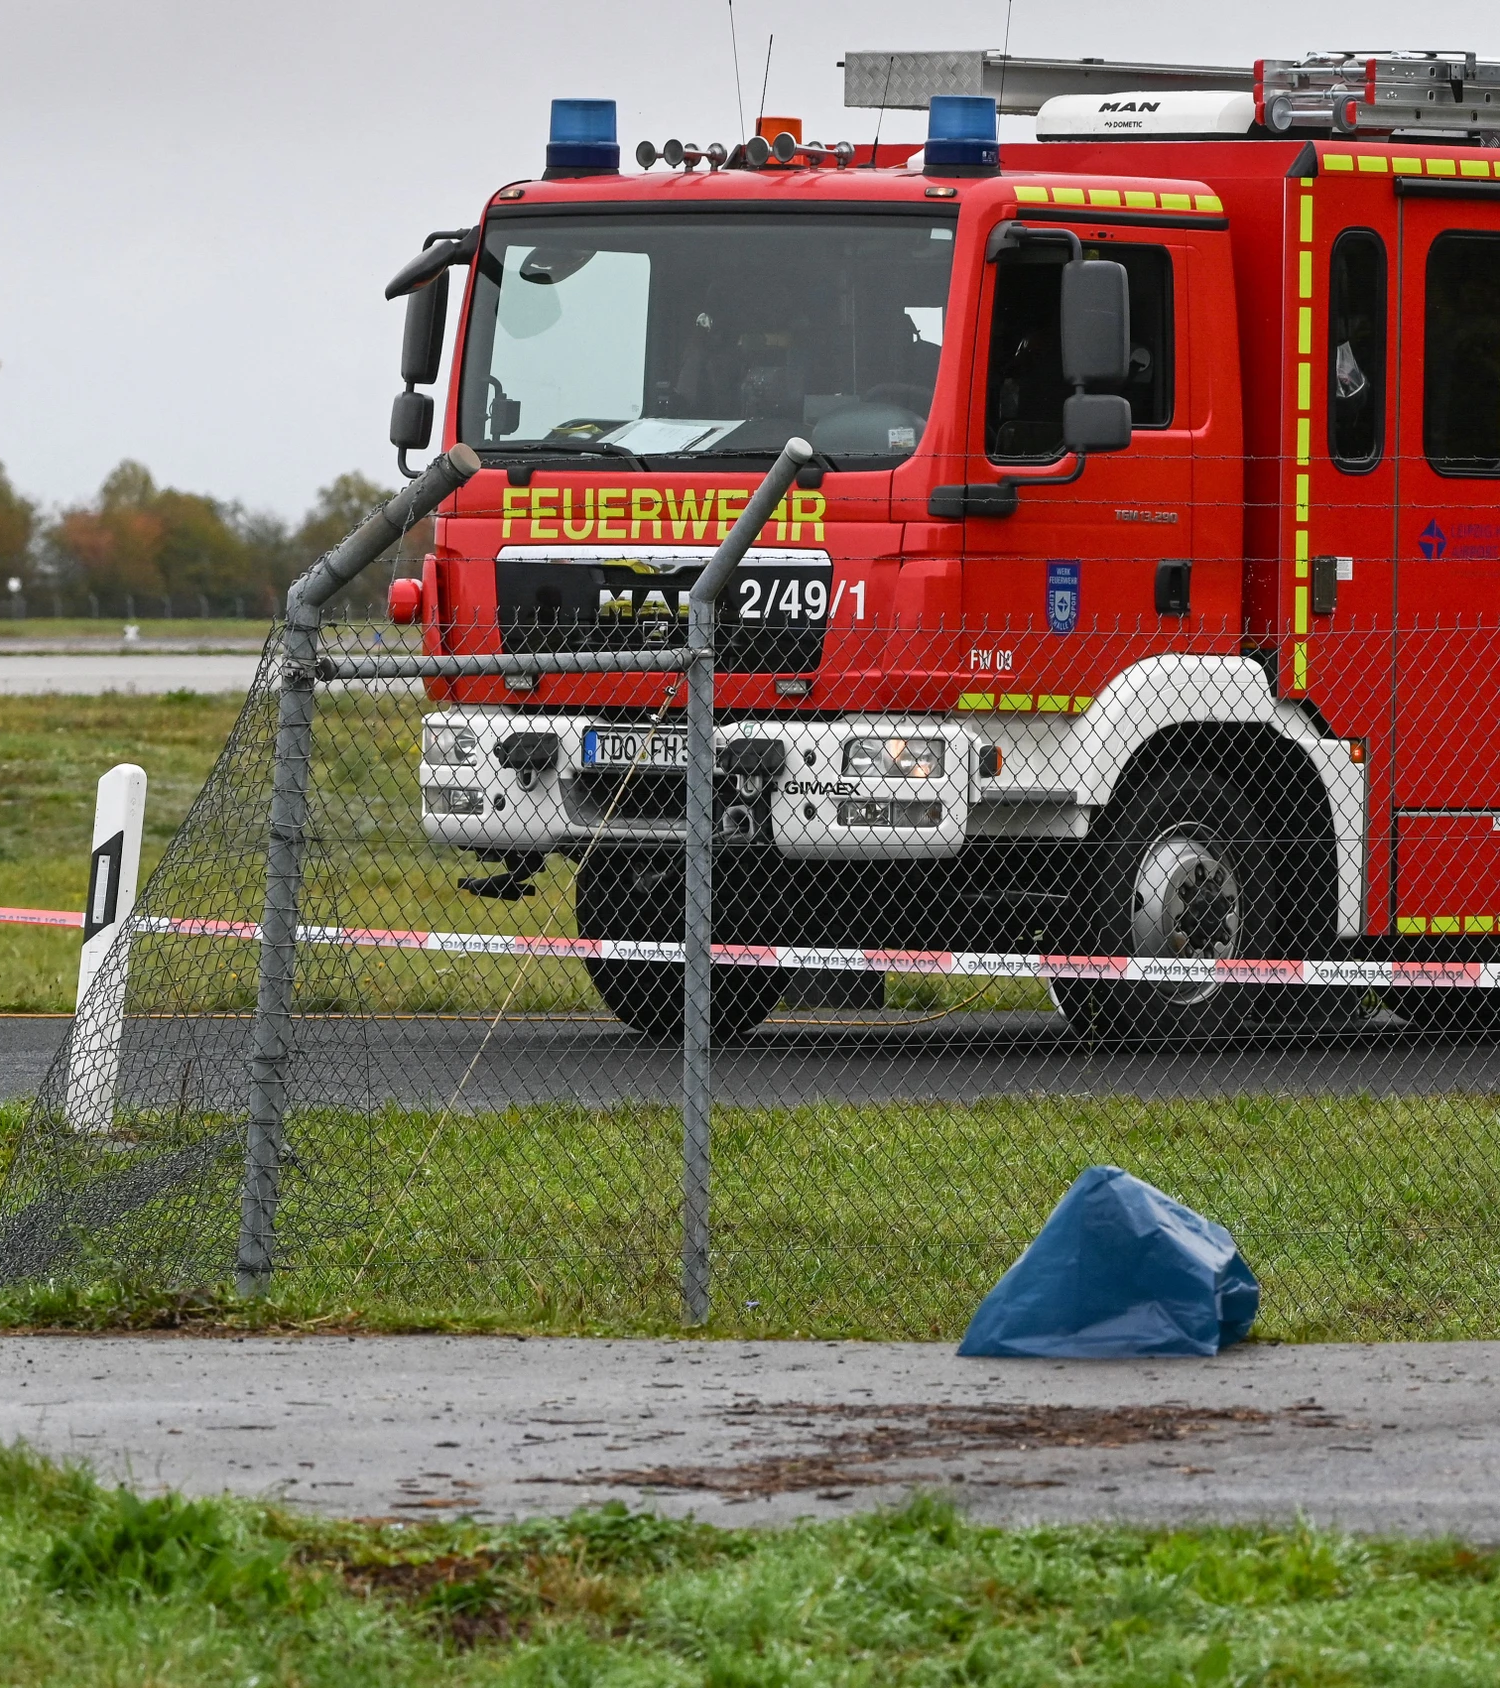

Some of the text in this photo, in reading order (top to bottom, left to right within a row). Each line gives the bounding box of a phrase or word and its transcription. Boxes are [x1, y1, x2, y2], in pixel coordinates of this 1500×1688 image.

[1098, 102, 1161, 112] MAN
[1114, 509, 1178, 523] TGM 13.290
[1451, 523, 1493, 538] LEIPZIG
[1451, 545, 1498, 560] AIRPORT
[1049, 576, 1078, 585] FEUERWEHR
[739, 579, 865, 620] 2/49/1
[970, 649, 993, 670] FW
[597, 735, 637, 761] TDO
[785, 781, 861, 796] GIMAEX
